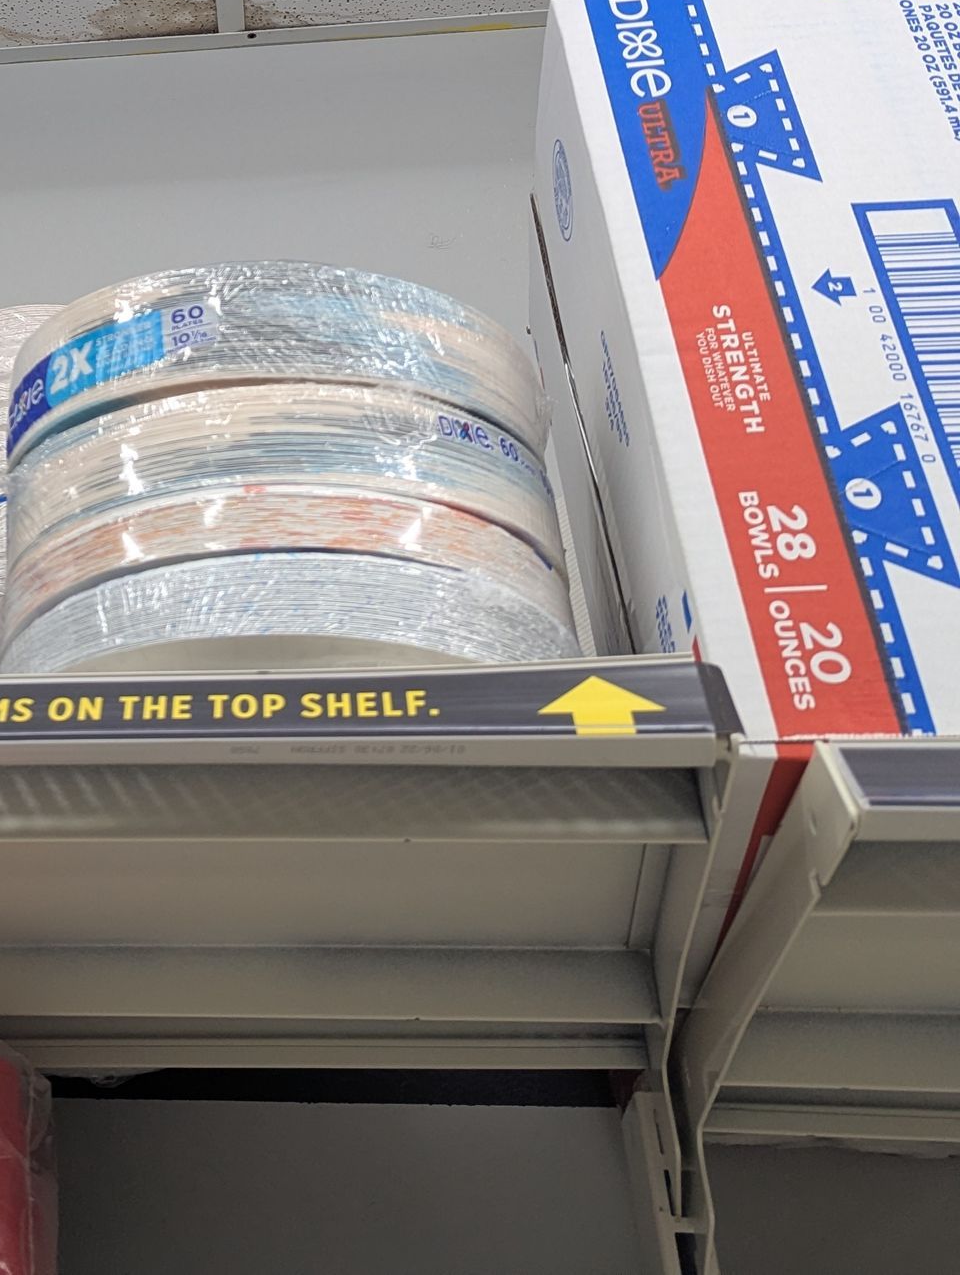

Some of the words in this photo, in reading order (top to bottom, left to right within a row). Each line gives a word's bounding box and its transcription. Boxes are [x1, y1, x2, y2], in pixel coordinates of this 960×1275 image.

[918, 4, 958, 72] PAQUETES
[935, 3, 953, 20] 20
[913, 35, 932, 52] 20
[922, 54, 941, 73] OZ
[637, 99, 685, 190] ULTRA
[171, 305, 204, 324] 60
[695, 331, 710, 355] YOU
[50, 339, 95, 396] 2X
[702, 356, 717, 383] DISH
[705, 327, 719, 350] FOR
[712, 351, 737, 413] WHATEVER
[712, 304, 765, 434] STRENGTH
[742, 331, 771, 402] ULTIMATE
[879, 333, 908, 382] 42000
[899, 393, 930, 444] 16767
[709, 384, 724, 409] OUT
[738, 490, 780, 579] BOWLS
[766, 504, 817, 561] 28
[768, 599, 816, 712] OUNCES
[799, 621, 852, 684] 20
[47, 696, 105, 722] ON
[119, 694, 193, 721] THE
[207, 691, 286, 719] TOP
[299, 689, 441, 718] SHELF.
